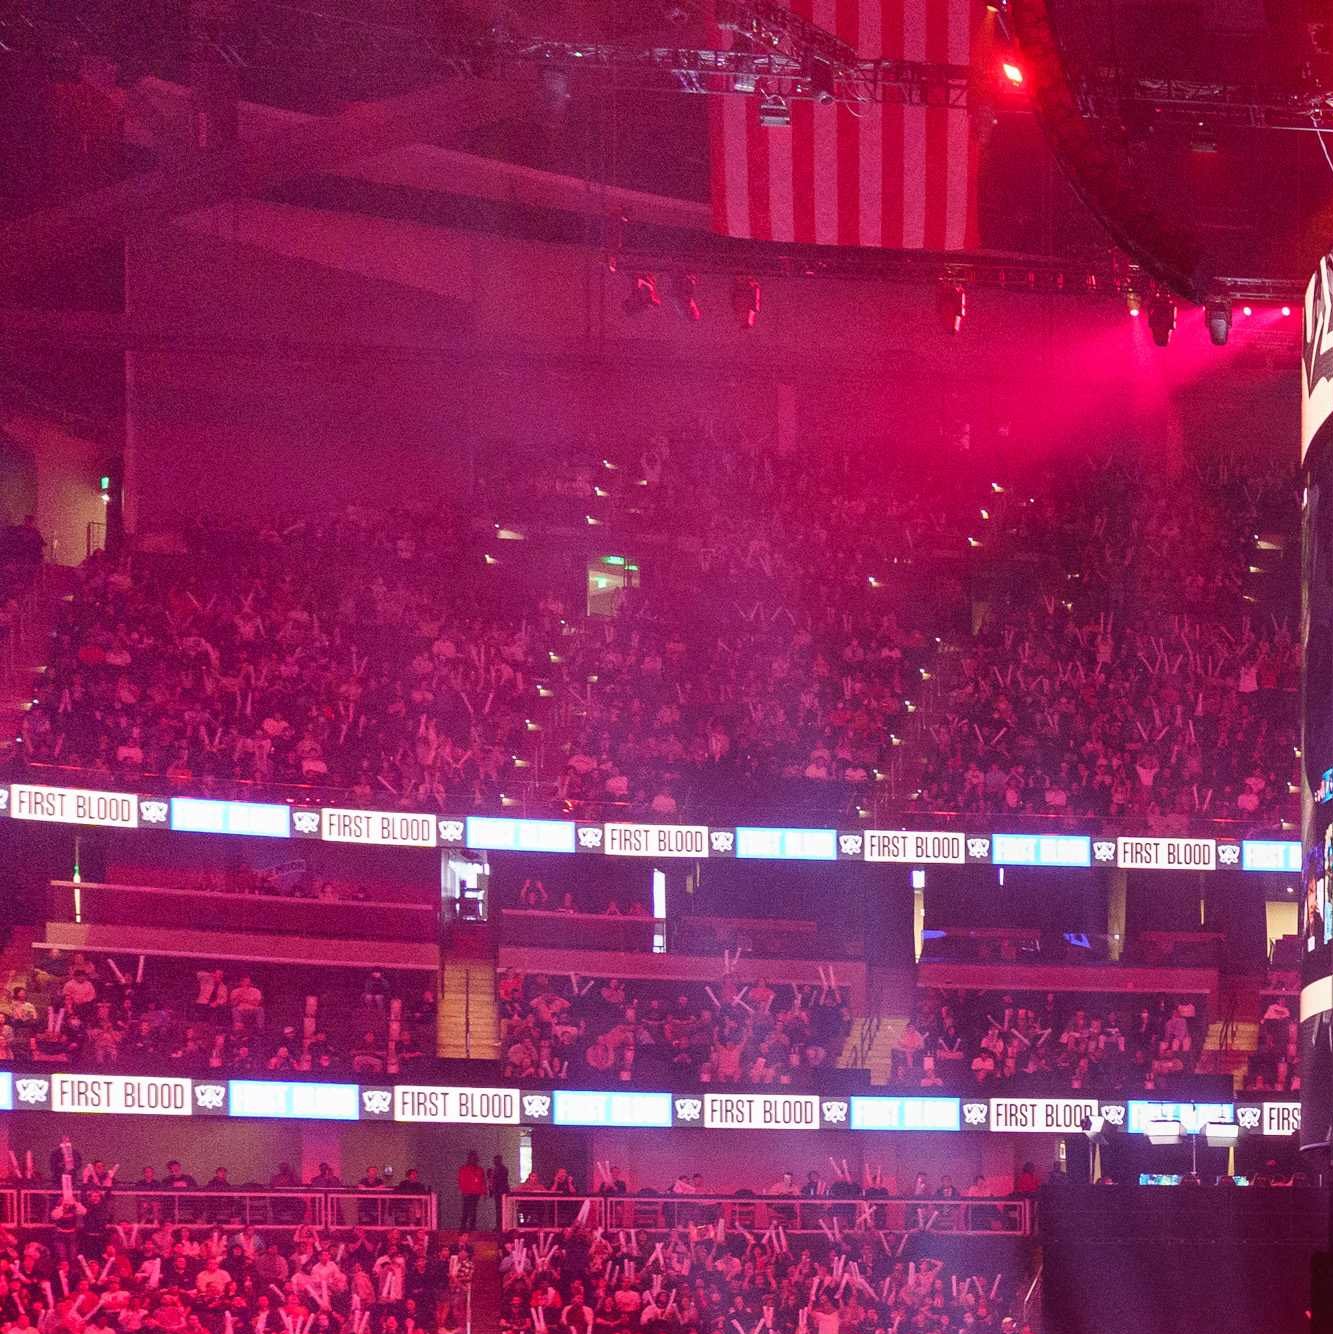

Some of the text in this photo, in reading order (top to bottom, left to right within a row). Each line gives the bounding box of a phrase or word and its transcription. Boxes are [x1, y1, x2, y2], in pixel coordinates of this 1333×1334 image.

[18, 790, 131, 824] FIRST BLOOD
[328, 813, 431, 843] FIRST BLOOD
[611, 828, 704, 854] FIRST BLOOD
[869, 834, 961, 861] FIRST BLOOD
[1122, 840, 1211, 866] FIRST BLOOD
[59, 1080, 185, 1110] FIRST BLOOD
[401, 1090, 514, 1119] FIRST BLOOD
[710, 1098, 814, 1126] FIRST BLOOD
[996, 1103, 1037, 1129] FIRST
